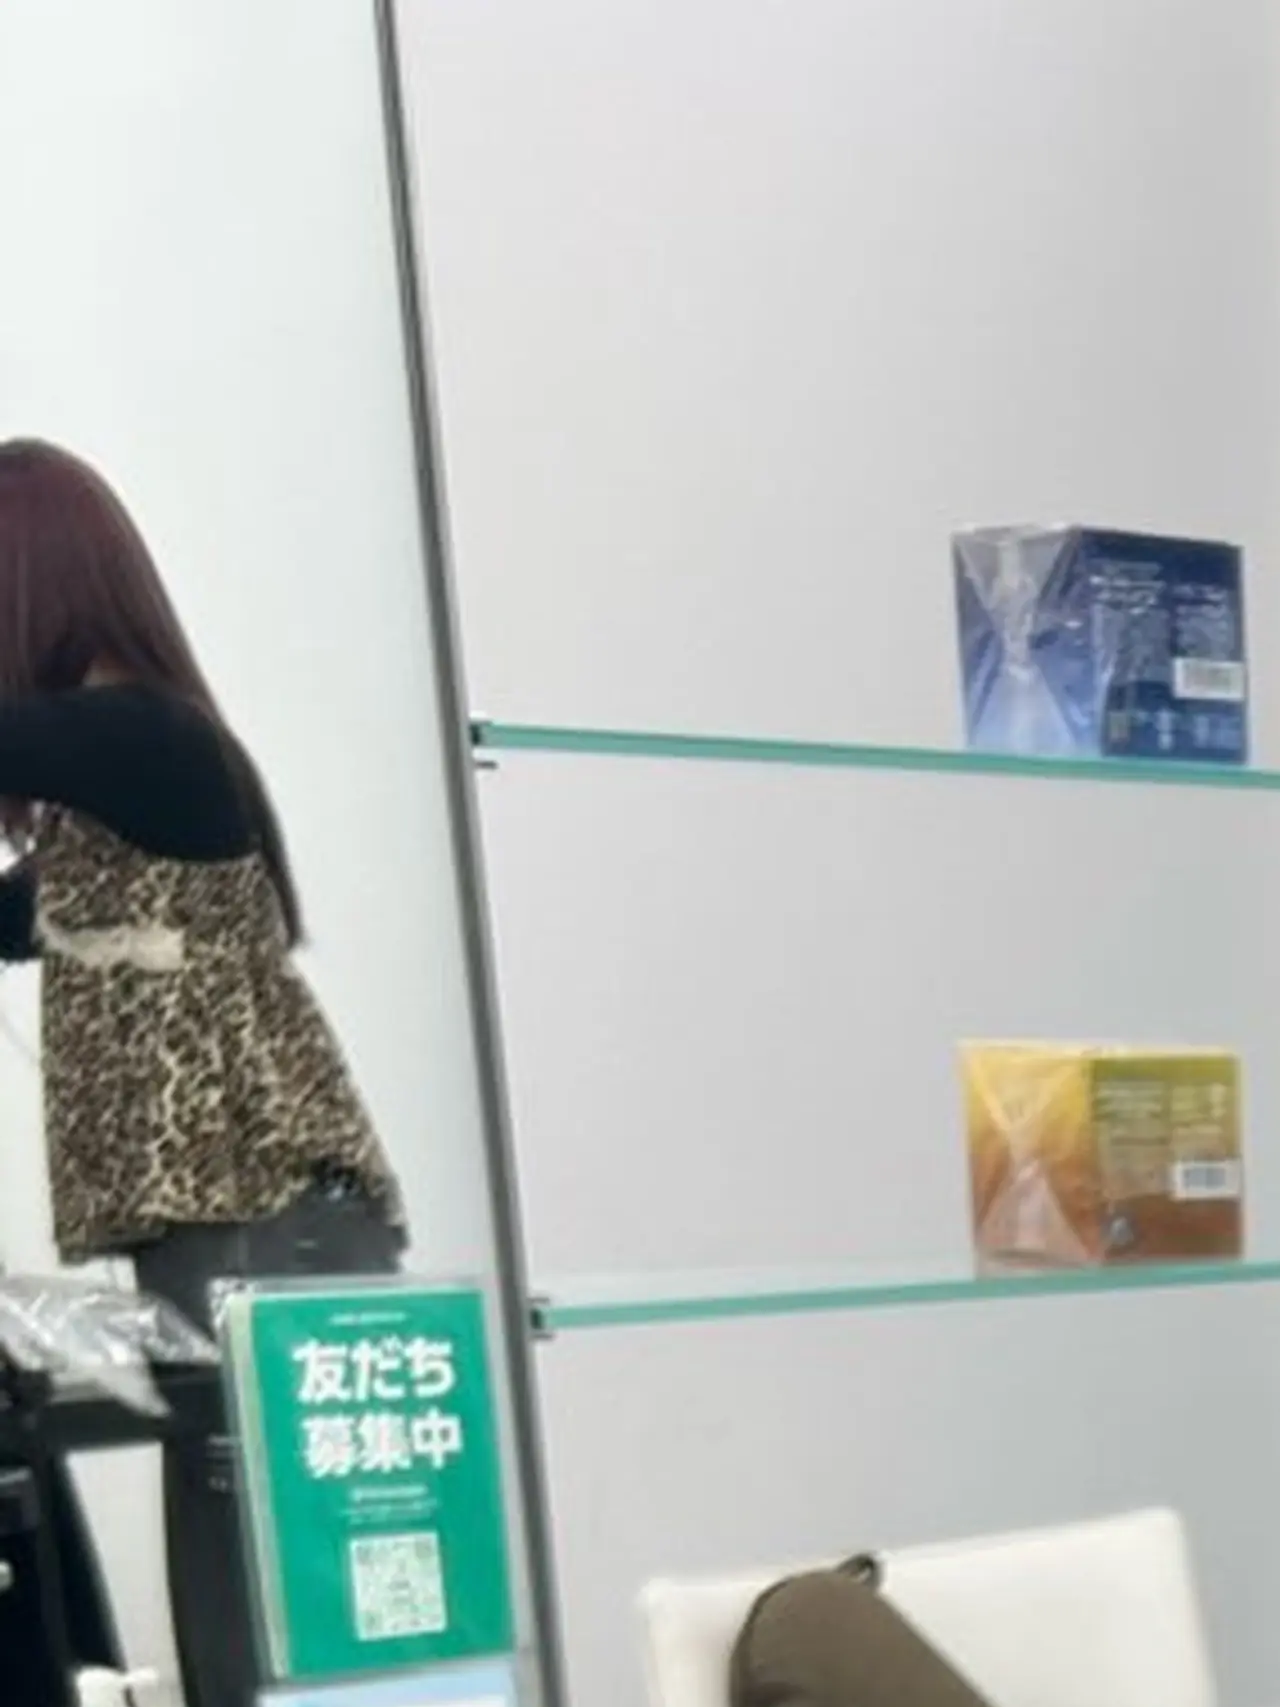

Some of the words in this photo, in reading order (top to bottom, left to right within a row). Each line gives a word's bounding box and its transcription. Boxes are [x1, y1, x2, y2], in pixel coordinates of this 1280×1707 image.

[292, 1335, 454, 1402] 友だち
[301, 1408, 463, 1477] 募集中
